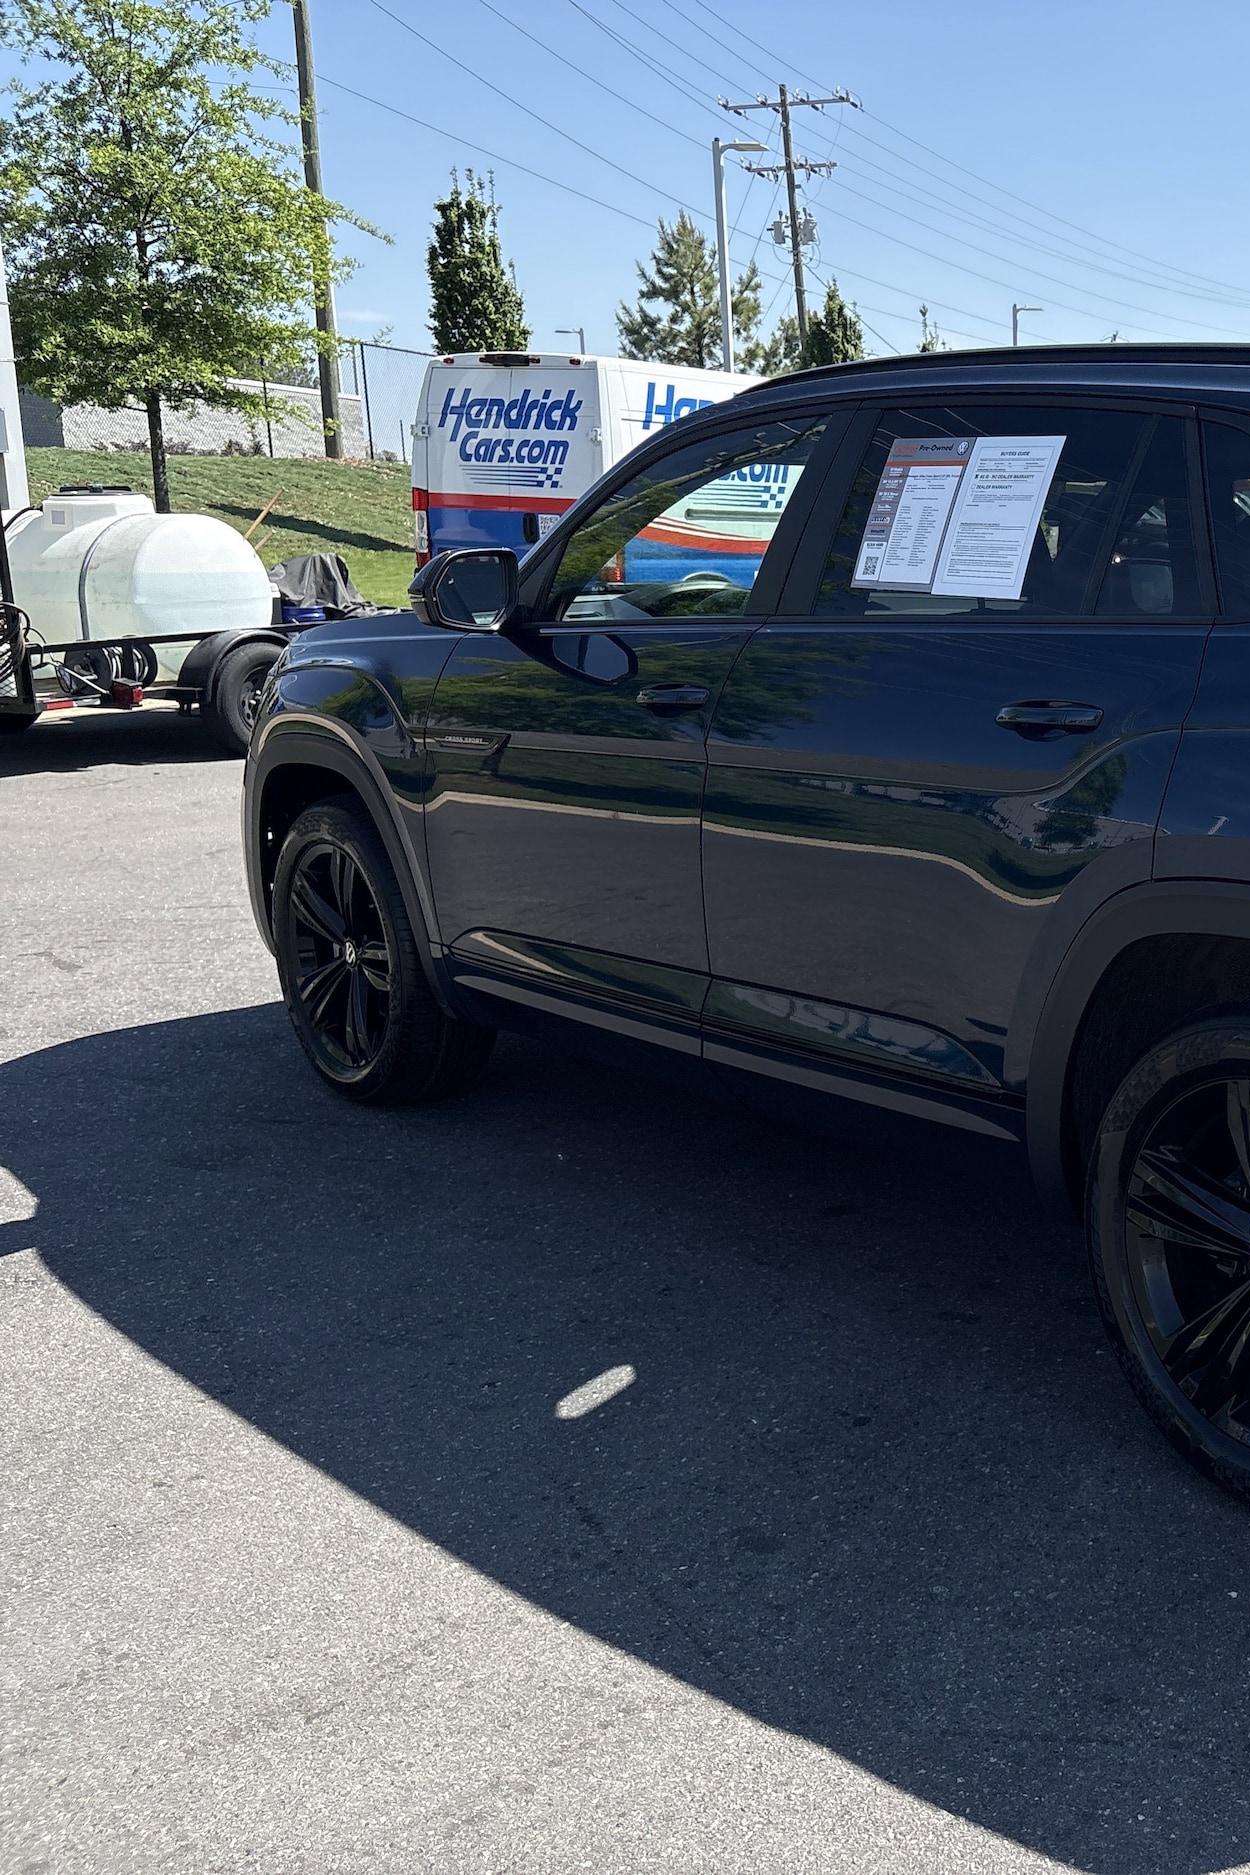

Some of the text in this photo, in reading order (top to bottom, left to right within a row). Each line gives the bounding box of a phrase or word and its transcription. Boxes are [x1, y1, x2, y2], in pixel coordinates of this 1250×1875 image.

[438, 388, 583, 442] Hendrick
[459, 431, 570, 465] Cars.com
[919, 443, 955, 452] Pre-Owned
